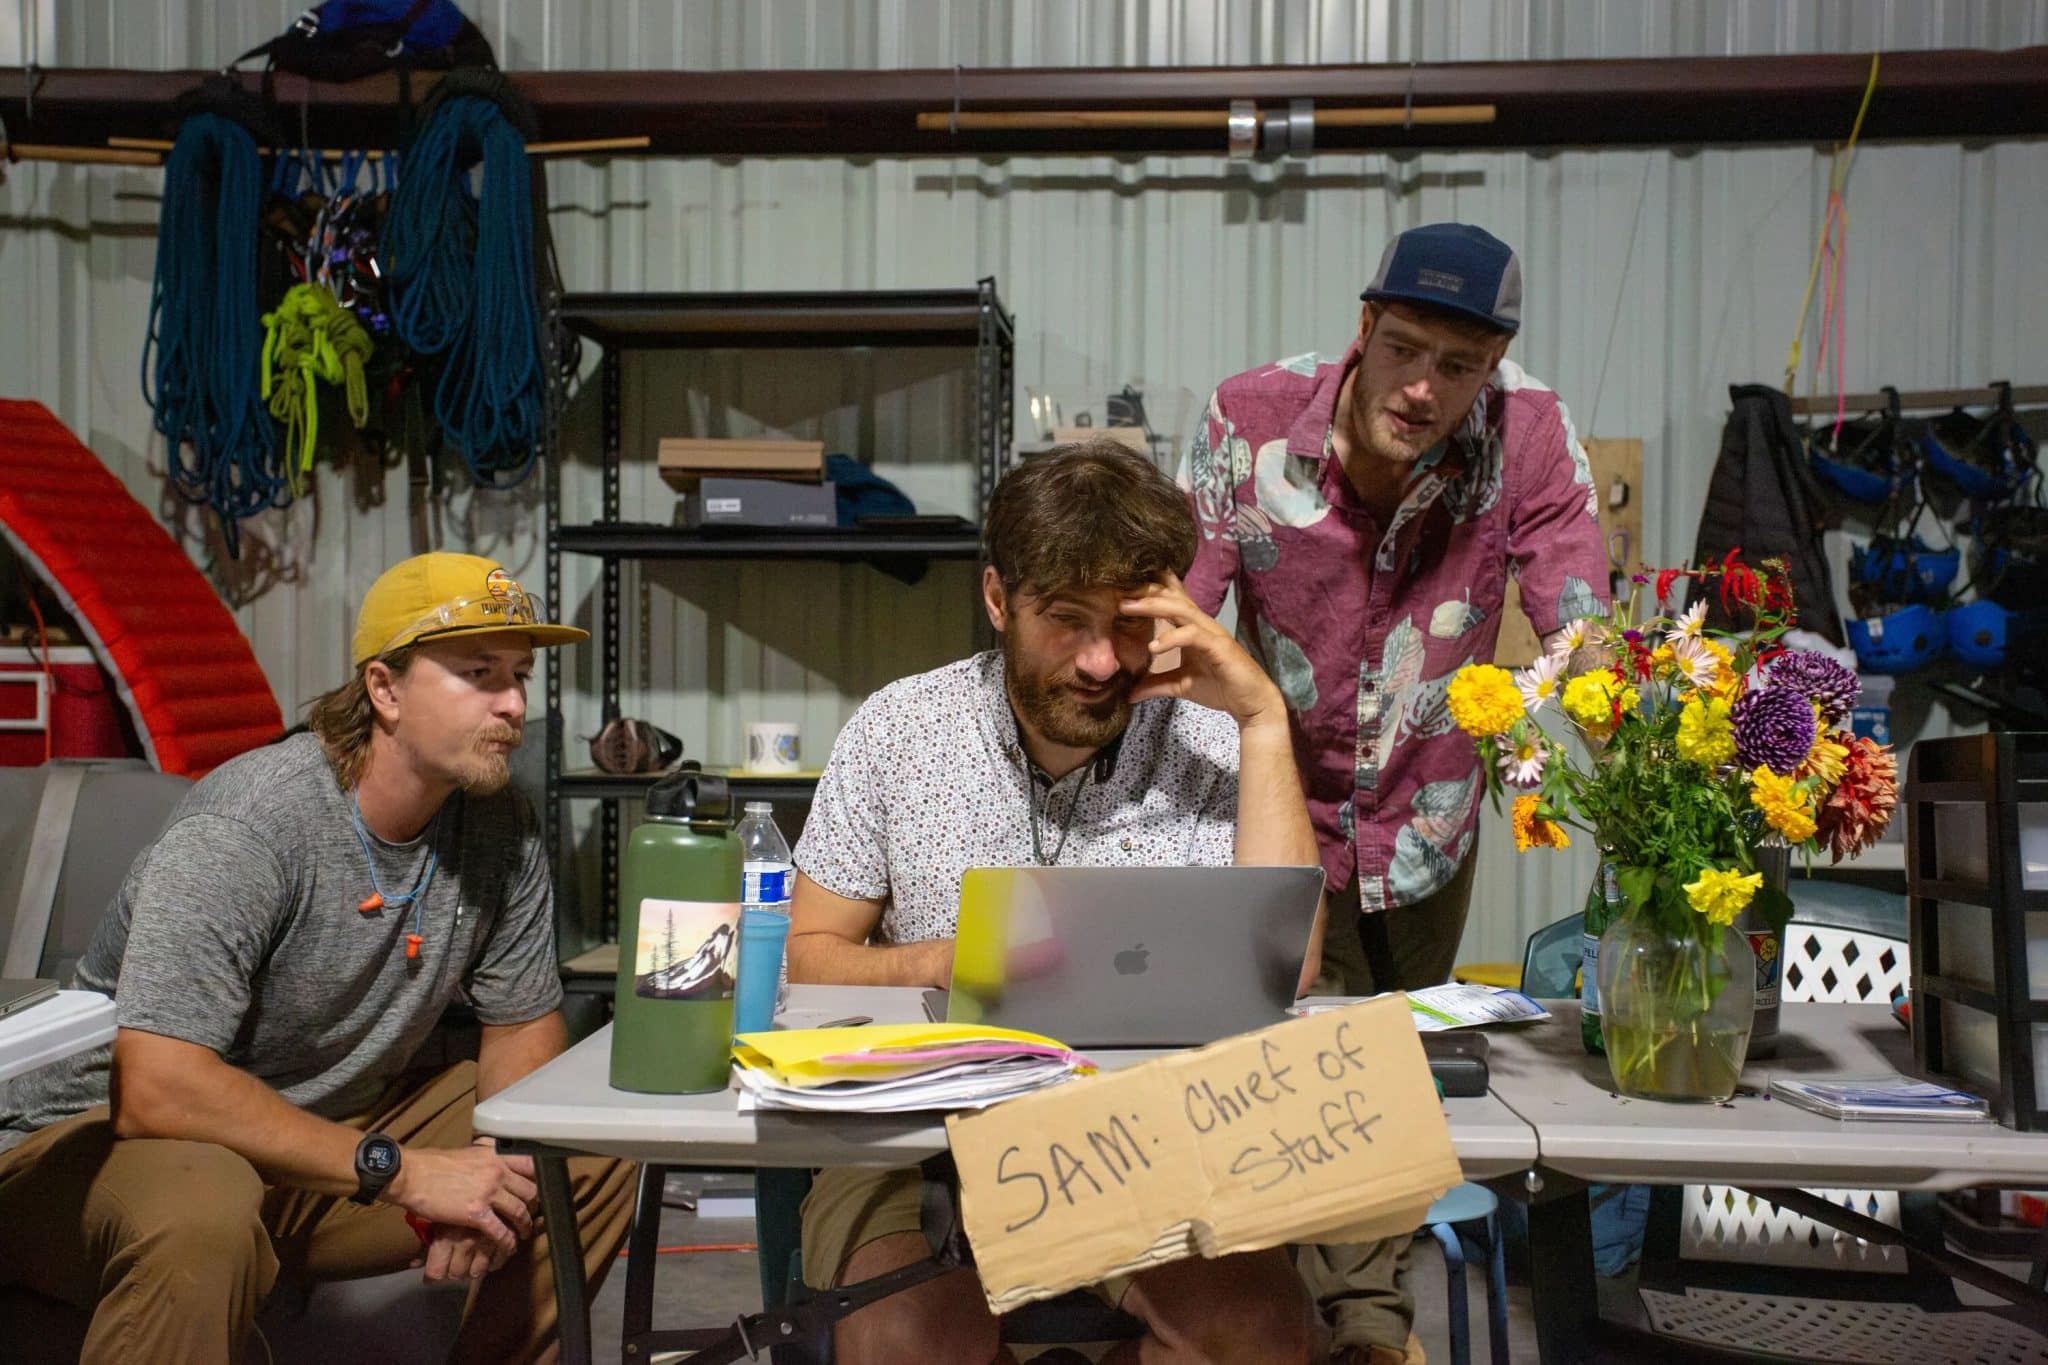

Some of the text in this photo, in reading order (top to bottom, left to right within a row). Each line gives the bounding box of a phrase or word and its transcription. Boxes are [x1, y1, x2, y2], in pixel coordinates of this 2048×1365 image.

[1184, 1040, 1297, 1135] Chief
[1317, 1022, 1367, 1081] of
[1230, 1090, 1383, 1193] Staff
